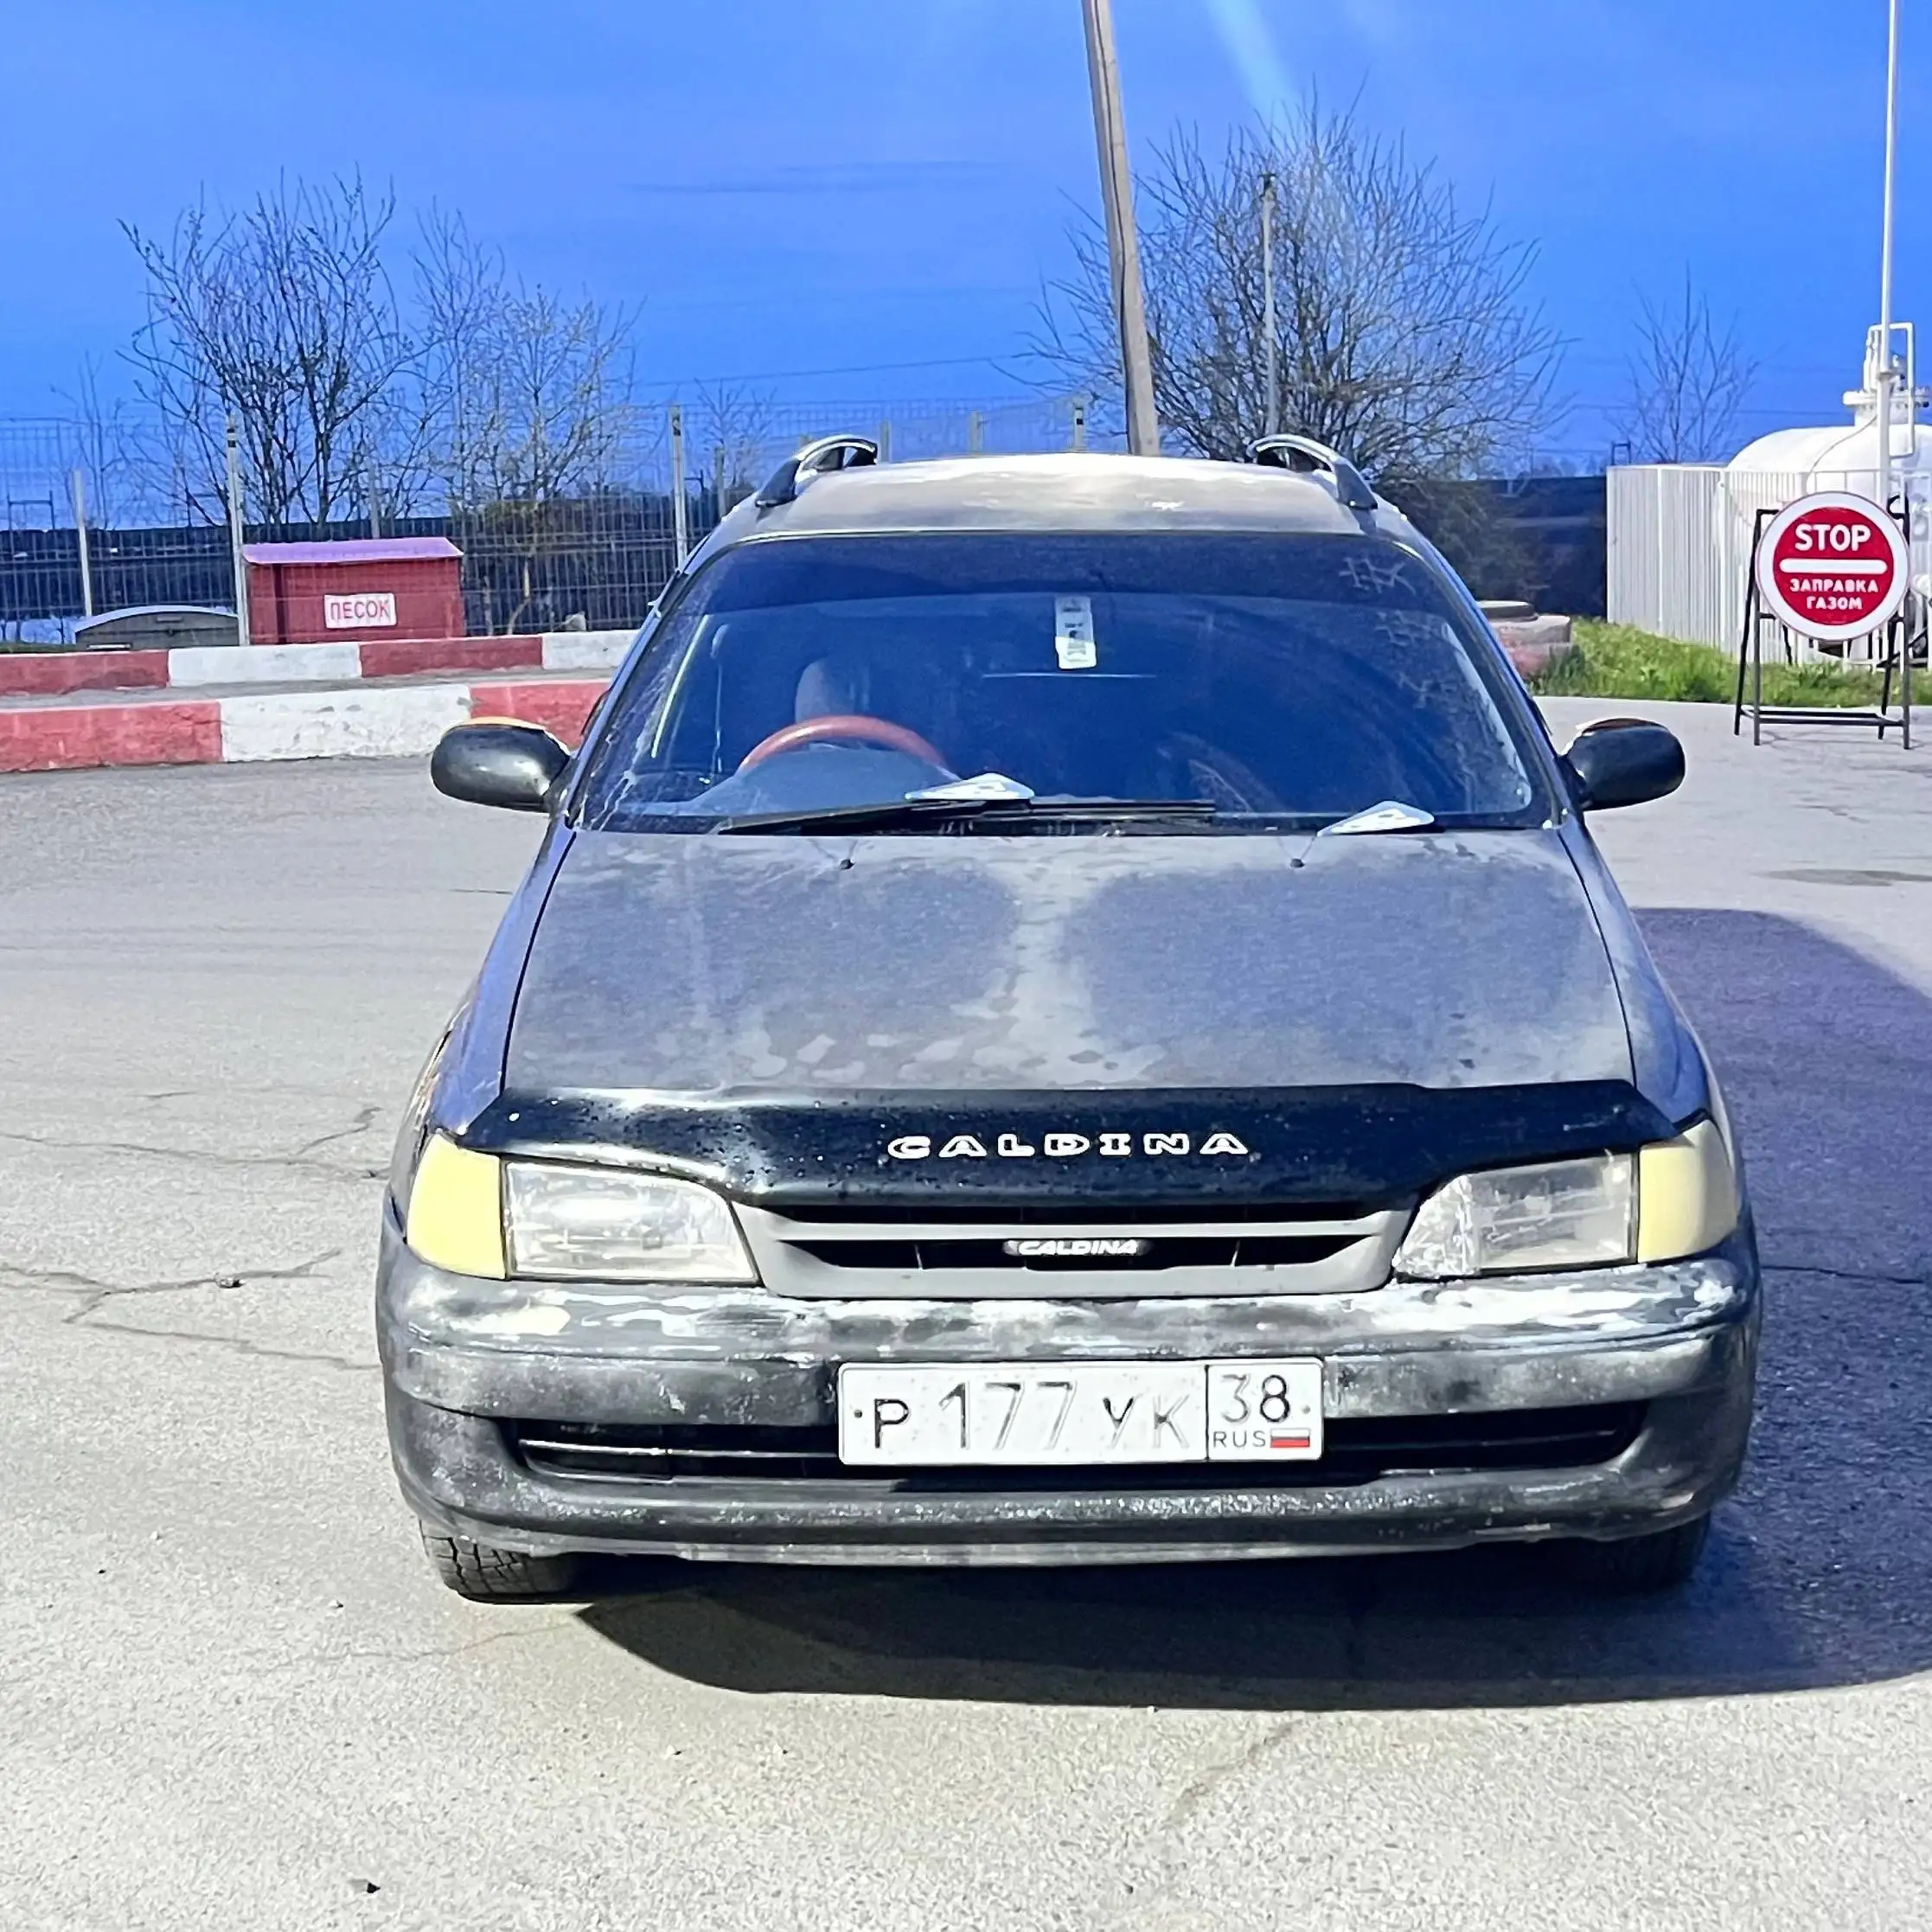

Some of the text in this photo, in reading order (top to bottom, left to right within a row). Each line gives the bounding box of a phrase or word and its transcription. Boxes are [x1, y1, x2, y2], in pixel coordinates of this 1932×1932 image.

[1794, 524, 1871, 551] STOP
[1790, 579, 1878, 593] ЗАПРАВКА
[331, 599, 389, 619] ПЕСОК
[1807, 596, 1862, 610] ГАЗОМ
[888, 1134, 1249, 1159] CALDINA
[1019, 1240, 1137, 1255] CALDINA
[938, 1382, 1078, 1449] 177
[1220, 1374, 1291, 1423] 38
[1212, 1430, 1266, 1448] RUS
